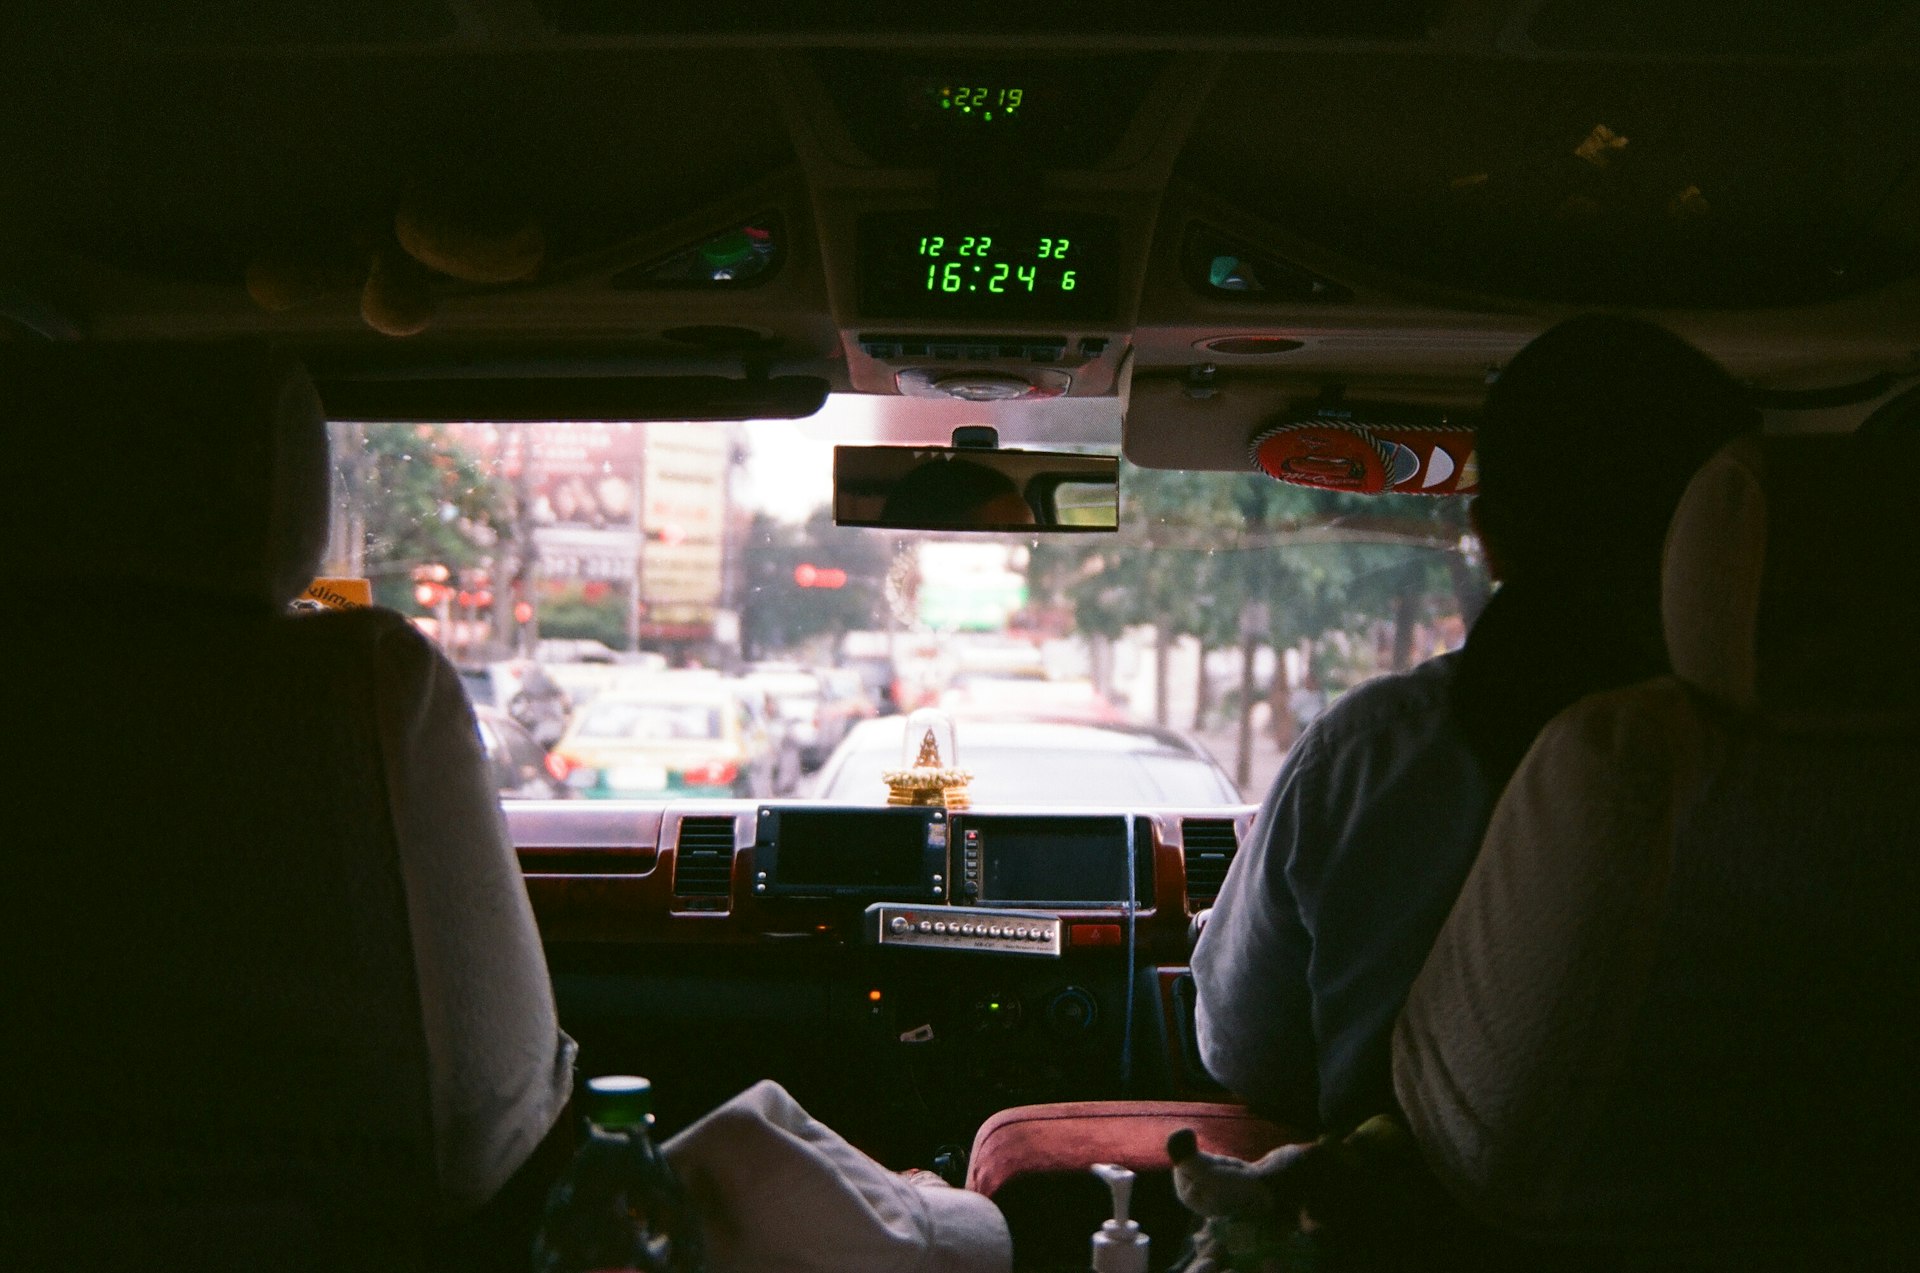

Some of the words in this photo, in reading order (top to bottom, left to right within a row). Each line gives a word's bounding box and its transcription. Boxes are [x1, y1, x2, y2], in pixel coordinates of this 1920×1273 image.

[920, 237, 944, 257] 12
[960, 237, 992, 257] 22
[1038, 238, 1069, 259] 32
[927, 263, 1036, 293] 16:24
[1061, 271, 1076, 291] 6
